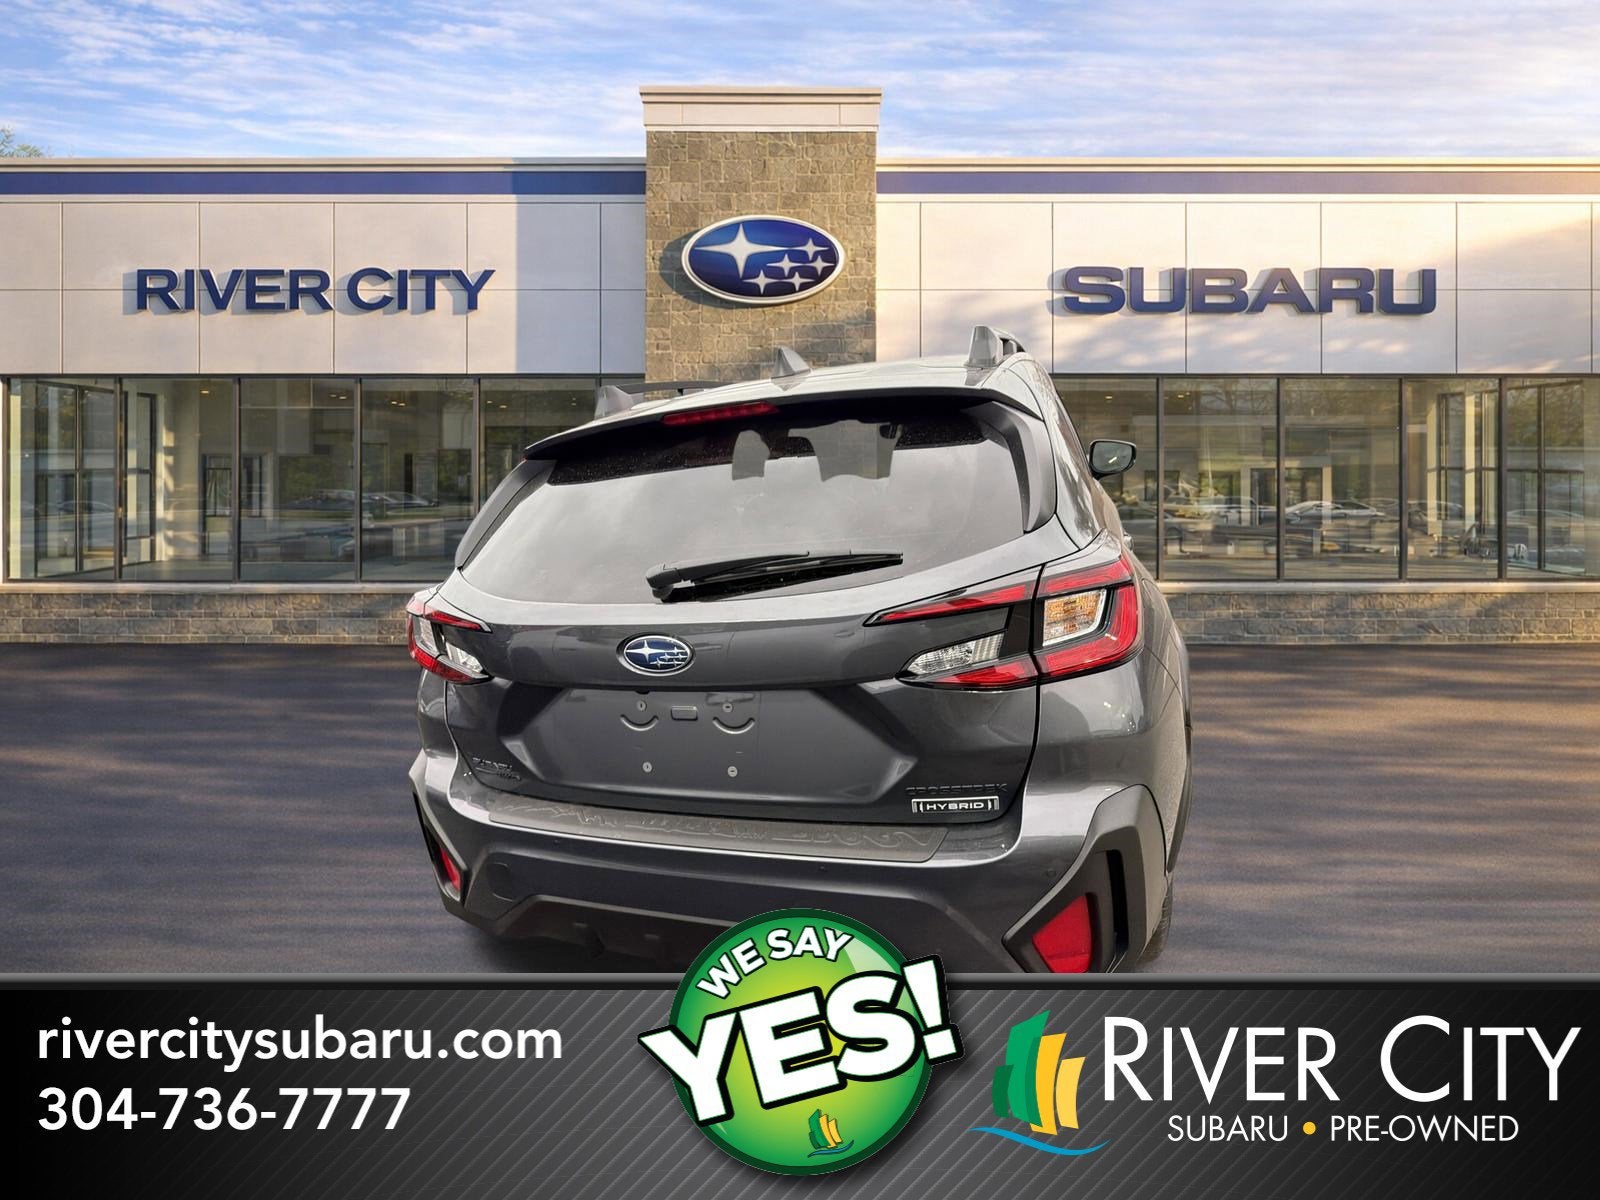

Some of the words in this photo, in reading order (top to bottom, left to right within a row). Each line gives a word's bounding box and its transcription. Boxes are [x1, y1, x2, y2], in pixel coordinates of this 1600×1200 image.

[136, 268, 334, 312] RIVER
[346, 267, 496, 312] CITY
[1063, 266, 1437, 316] SUBARU
[926, 801, 985, 811] HYBRID
